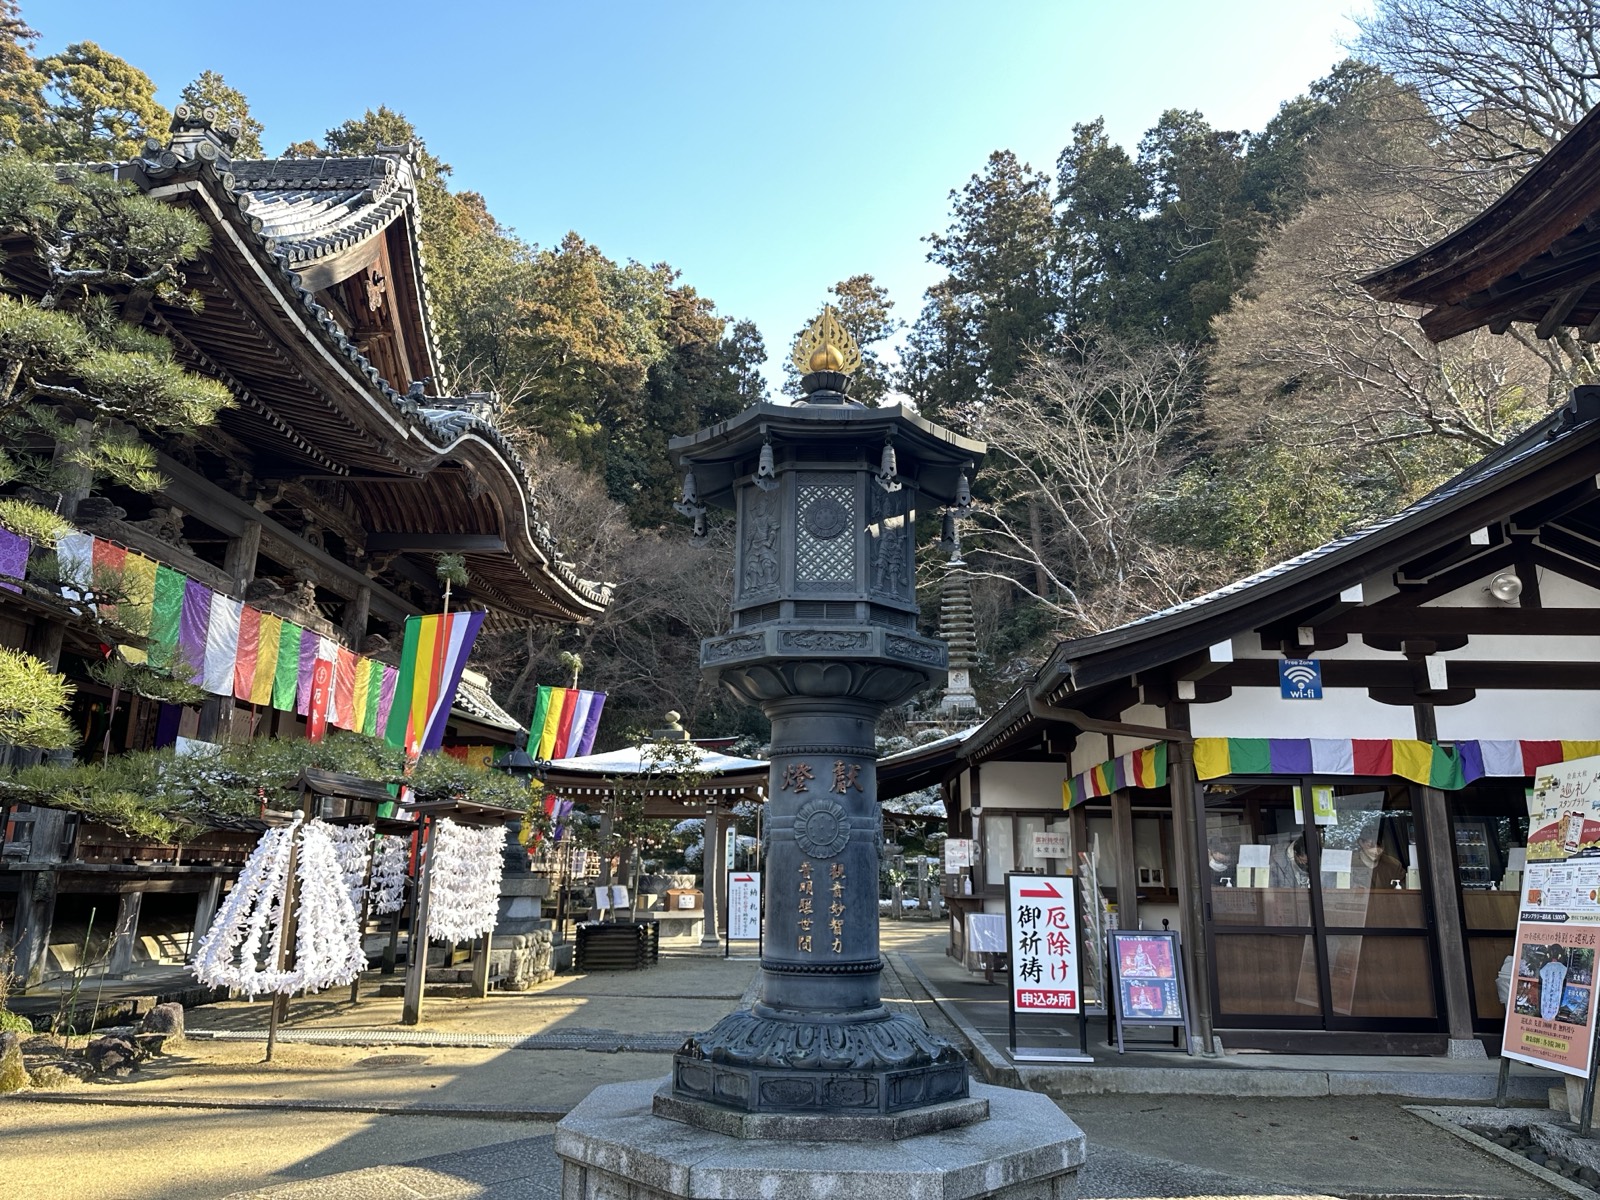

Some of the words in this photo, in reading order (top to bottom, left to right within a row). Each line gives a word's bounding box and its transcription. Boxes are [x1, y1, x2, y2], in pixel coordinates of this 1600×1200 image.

[1560, 781, 1592, 798] 巡礼
[1559, 798, 1591, 809] スタンプラリー
[1017, 904, 1044, 984] 御祈祷
[1046, 905, 1072, 984] 厄除け
[1021, 992, 1072, 1007] 申込み所
